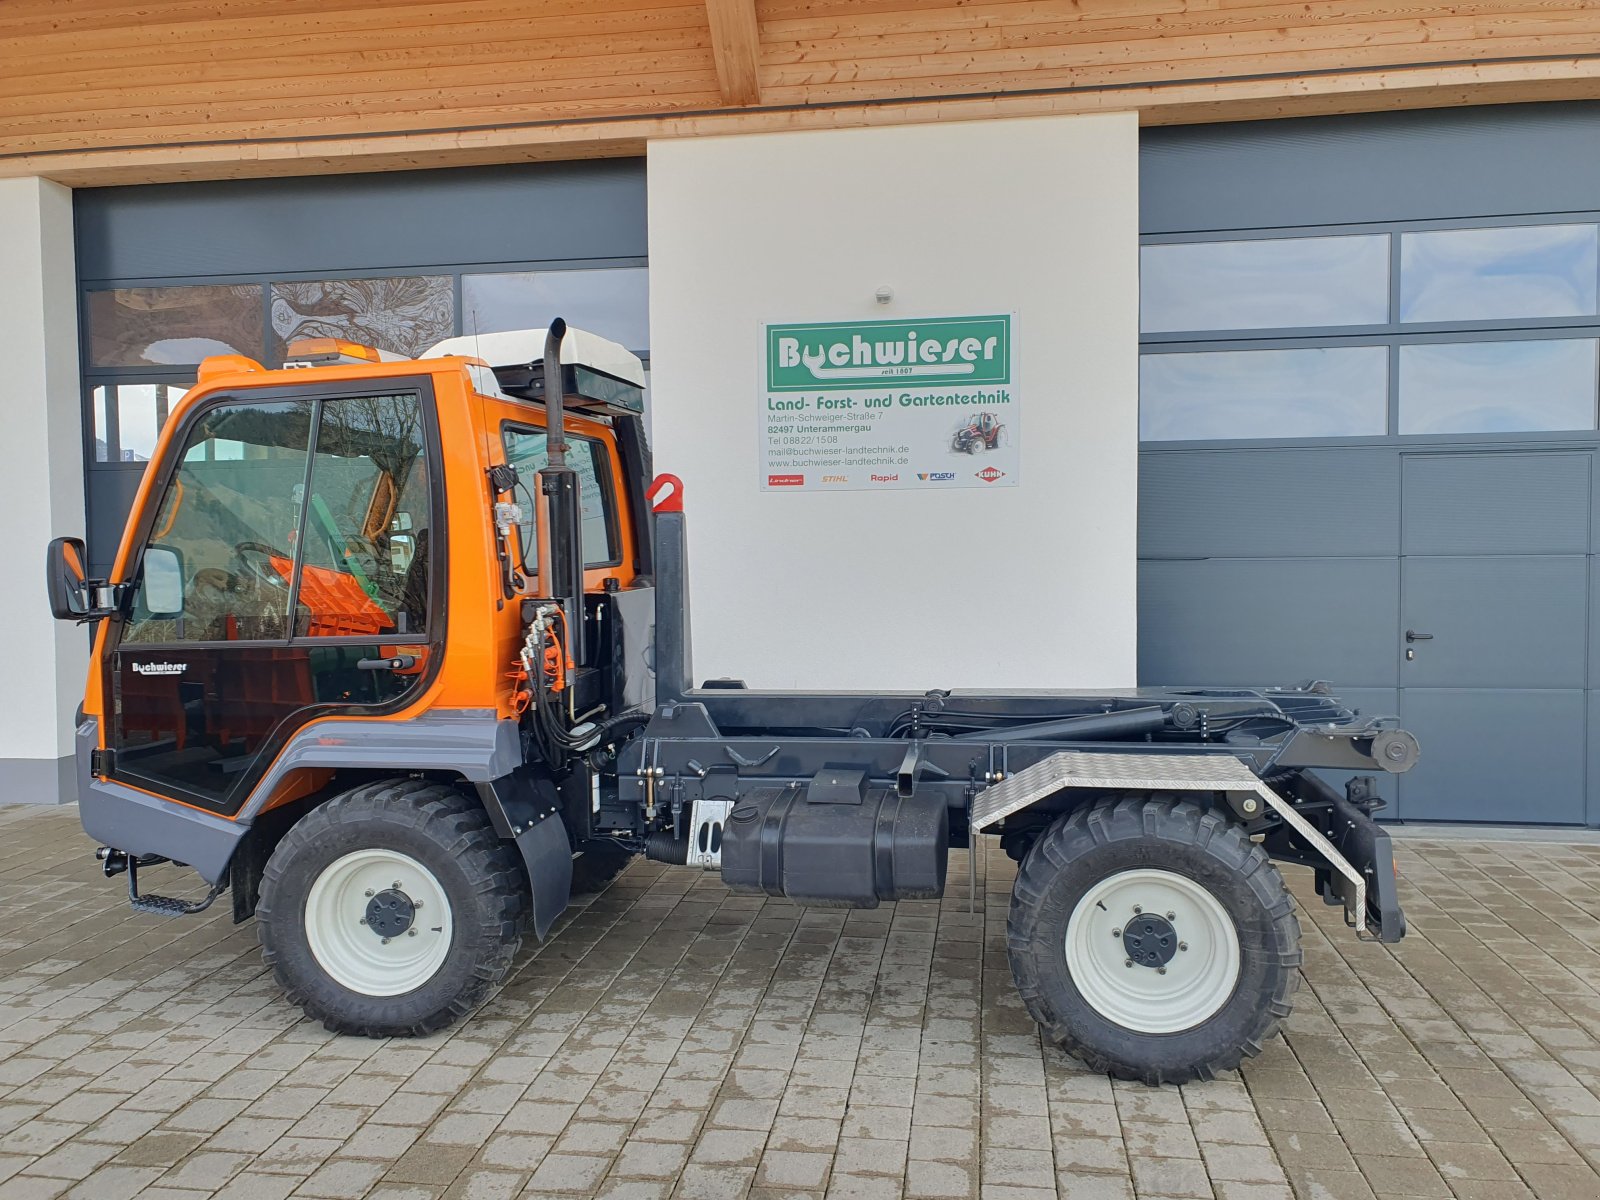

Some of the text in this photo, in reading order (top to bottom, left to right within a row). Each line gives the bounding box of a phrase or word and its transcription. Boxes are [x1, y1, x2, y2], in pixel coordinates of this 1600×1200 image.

[778, 331, 998, 369] Buchwieser
[881, 367, 894, 375] seit
[767, 390, 1011, 411] Land- Forst- und Gartentechnik
[767, 411, 884, 424] Martin-Schweiger-Straße 7
[767, 424, 872, 436] 82497 Unterammergau
[767, 435, 838, 446] Tel 08822/1508
[768, 445, 910, 457] mail@buchwieser-landtechnik.de
[768, 456, 909, 468] www.buchwieser-landtechnik.de
[821, 475, 849, 483] STIHL
[870, 473, 899, 483] Rapid
[132, 661, 188, 675] Buchwieser
